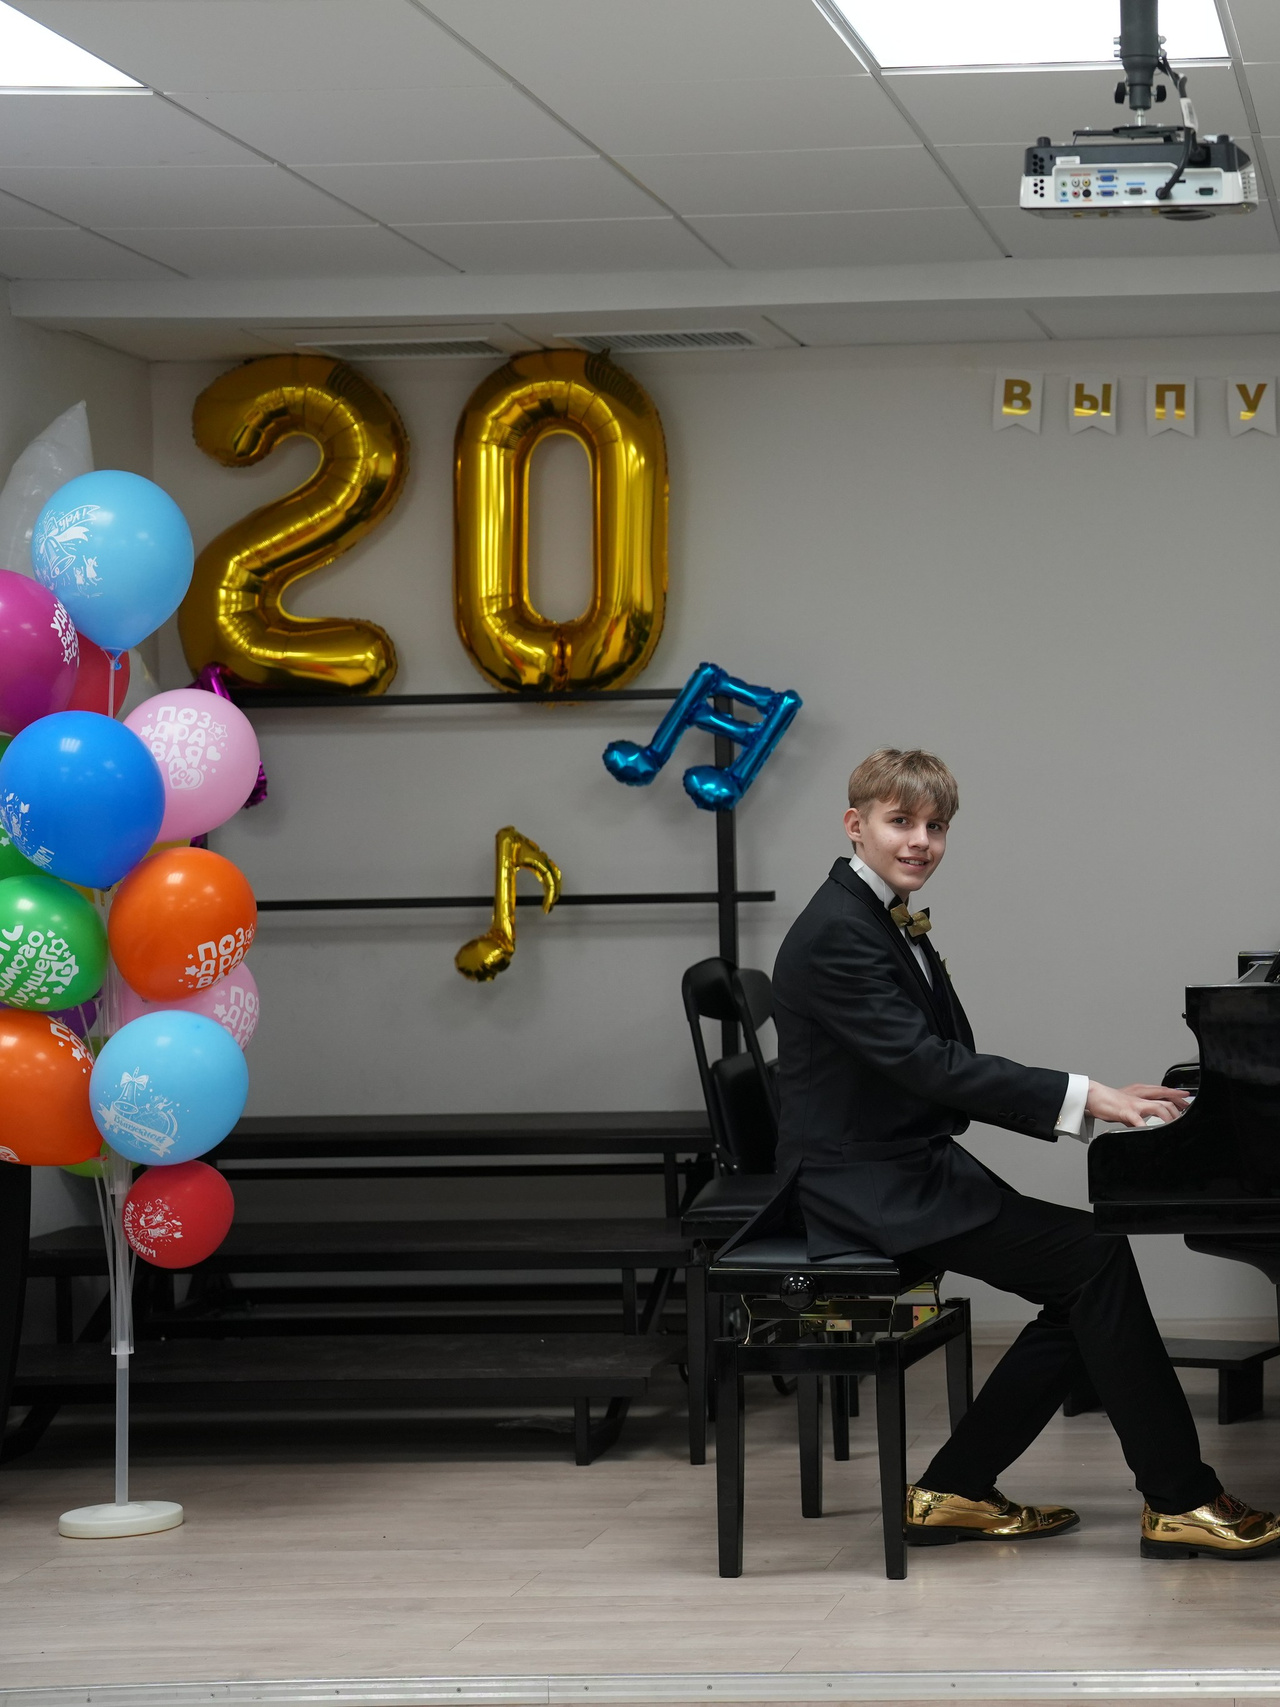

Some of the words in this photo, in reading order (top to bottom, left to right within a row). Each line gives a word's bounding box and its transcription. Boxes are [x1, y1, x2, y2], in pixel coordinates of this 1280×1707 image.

[157, 706, 211, 729] ПОЗ
[149, 721, 206, 747] ДРА
[197, 927, 245, 962] ПОЗ
